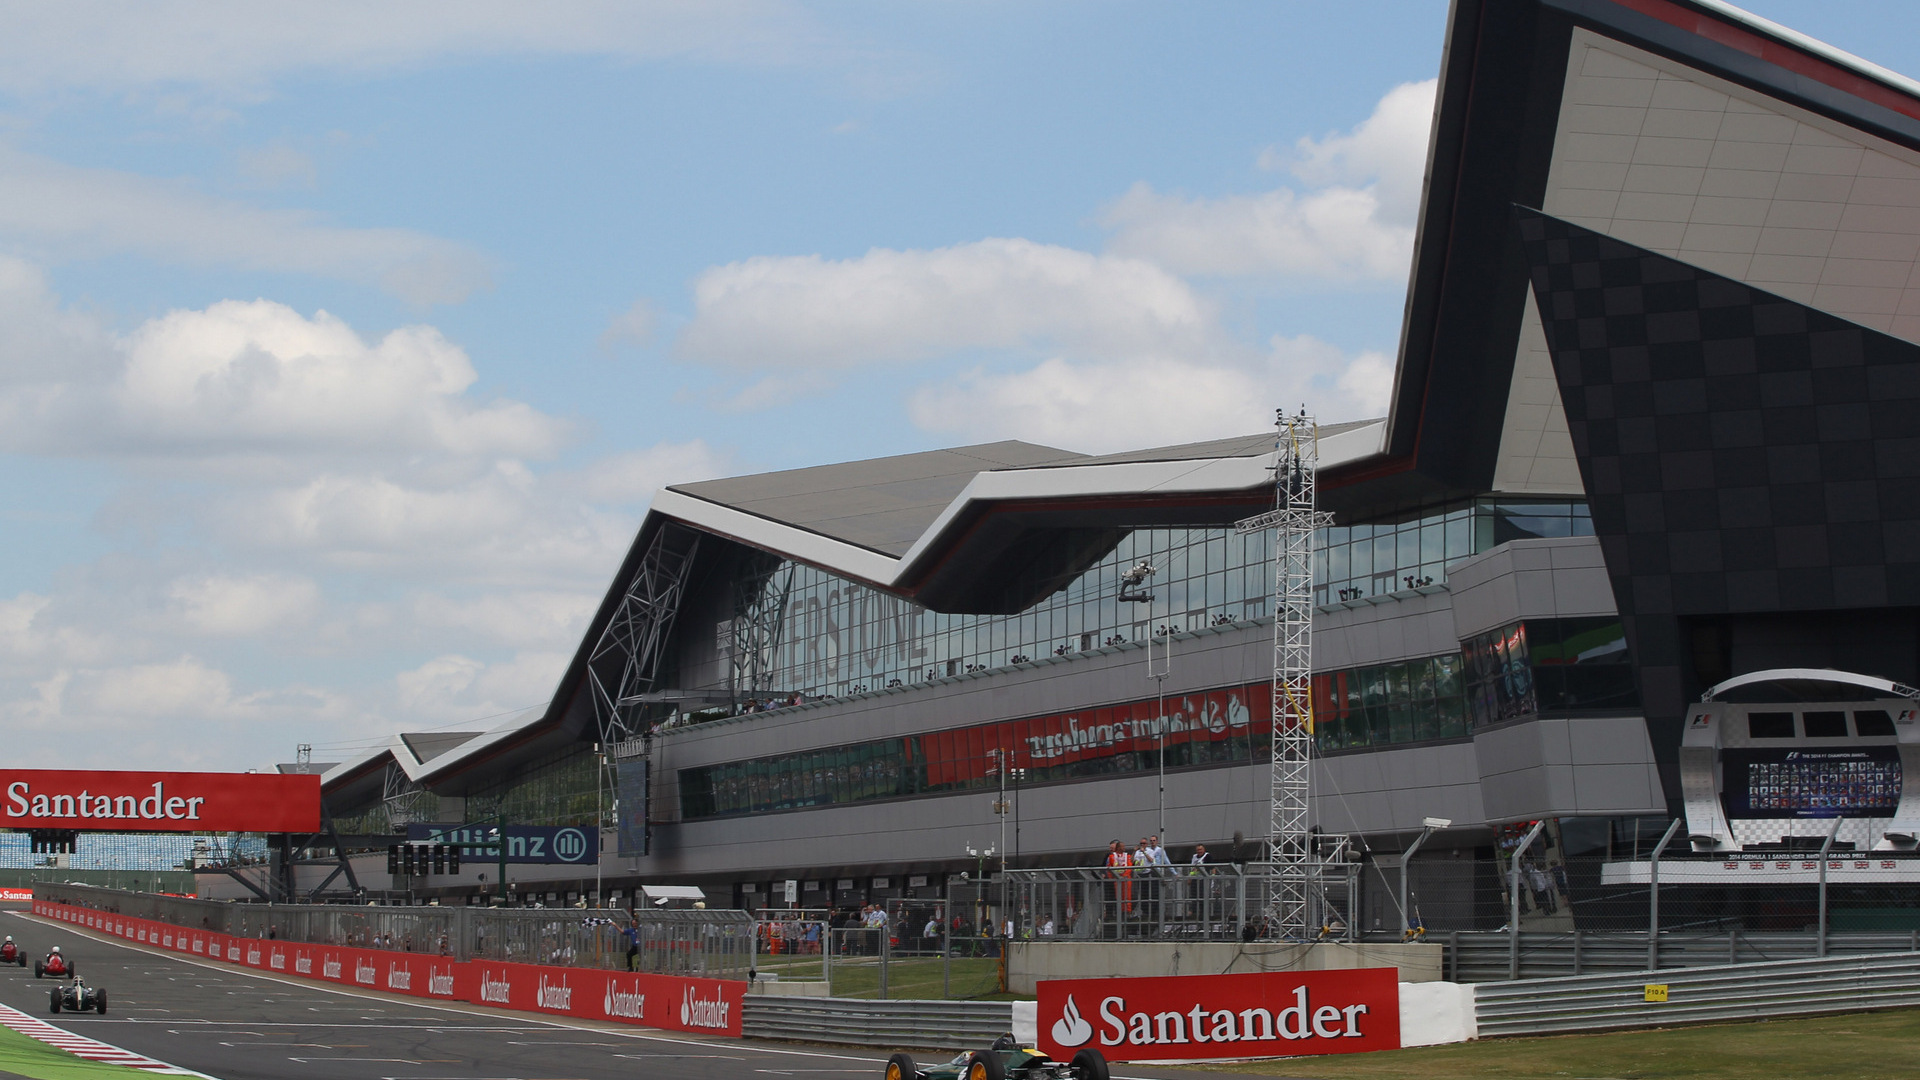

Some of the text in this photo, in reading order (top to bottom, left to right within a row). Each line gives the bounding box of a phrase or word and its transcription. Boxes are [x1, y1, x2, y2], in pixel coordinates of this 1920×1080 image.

[7, 781, 204, 819] Santander
[486, 969, 510, 1003] Santander
[543, 973, 572, 1010] Santander
[611, 978, 645, 1019] Santander
[689, 983, 730, 1029] Santander
[1100, 986, 1367, 1046] Santander
